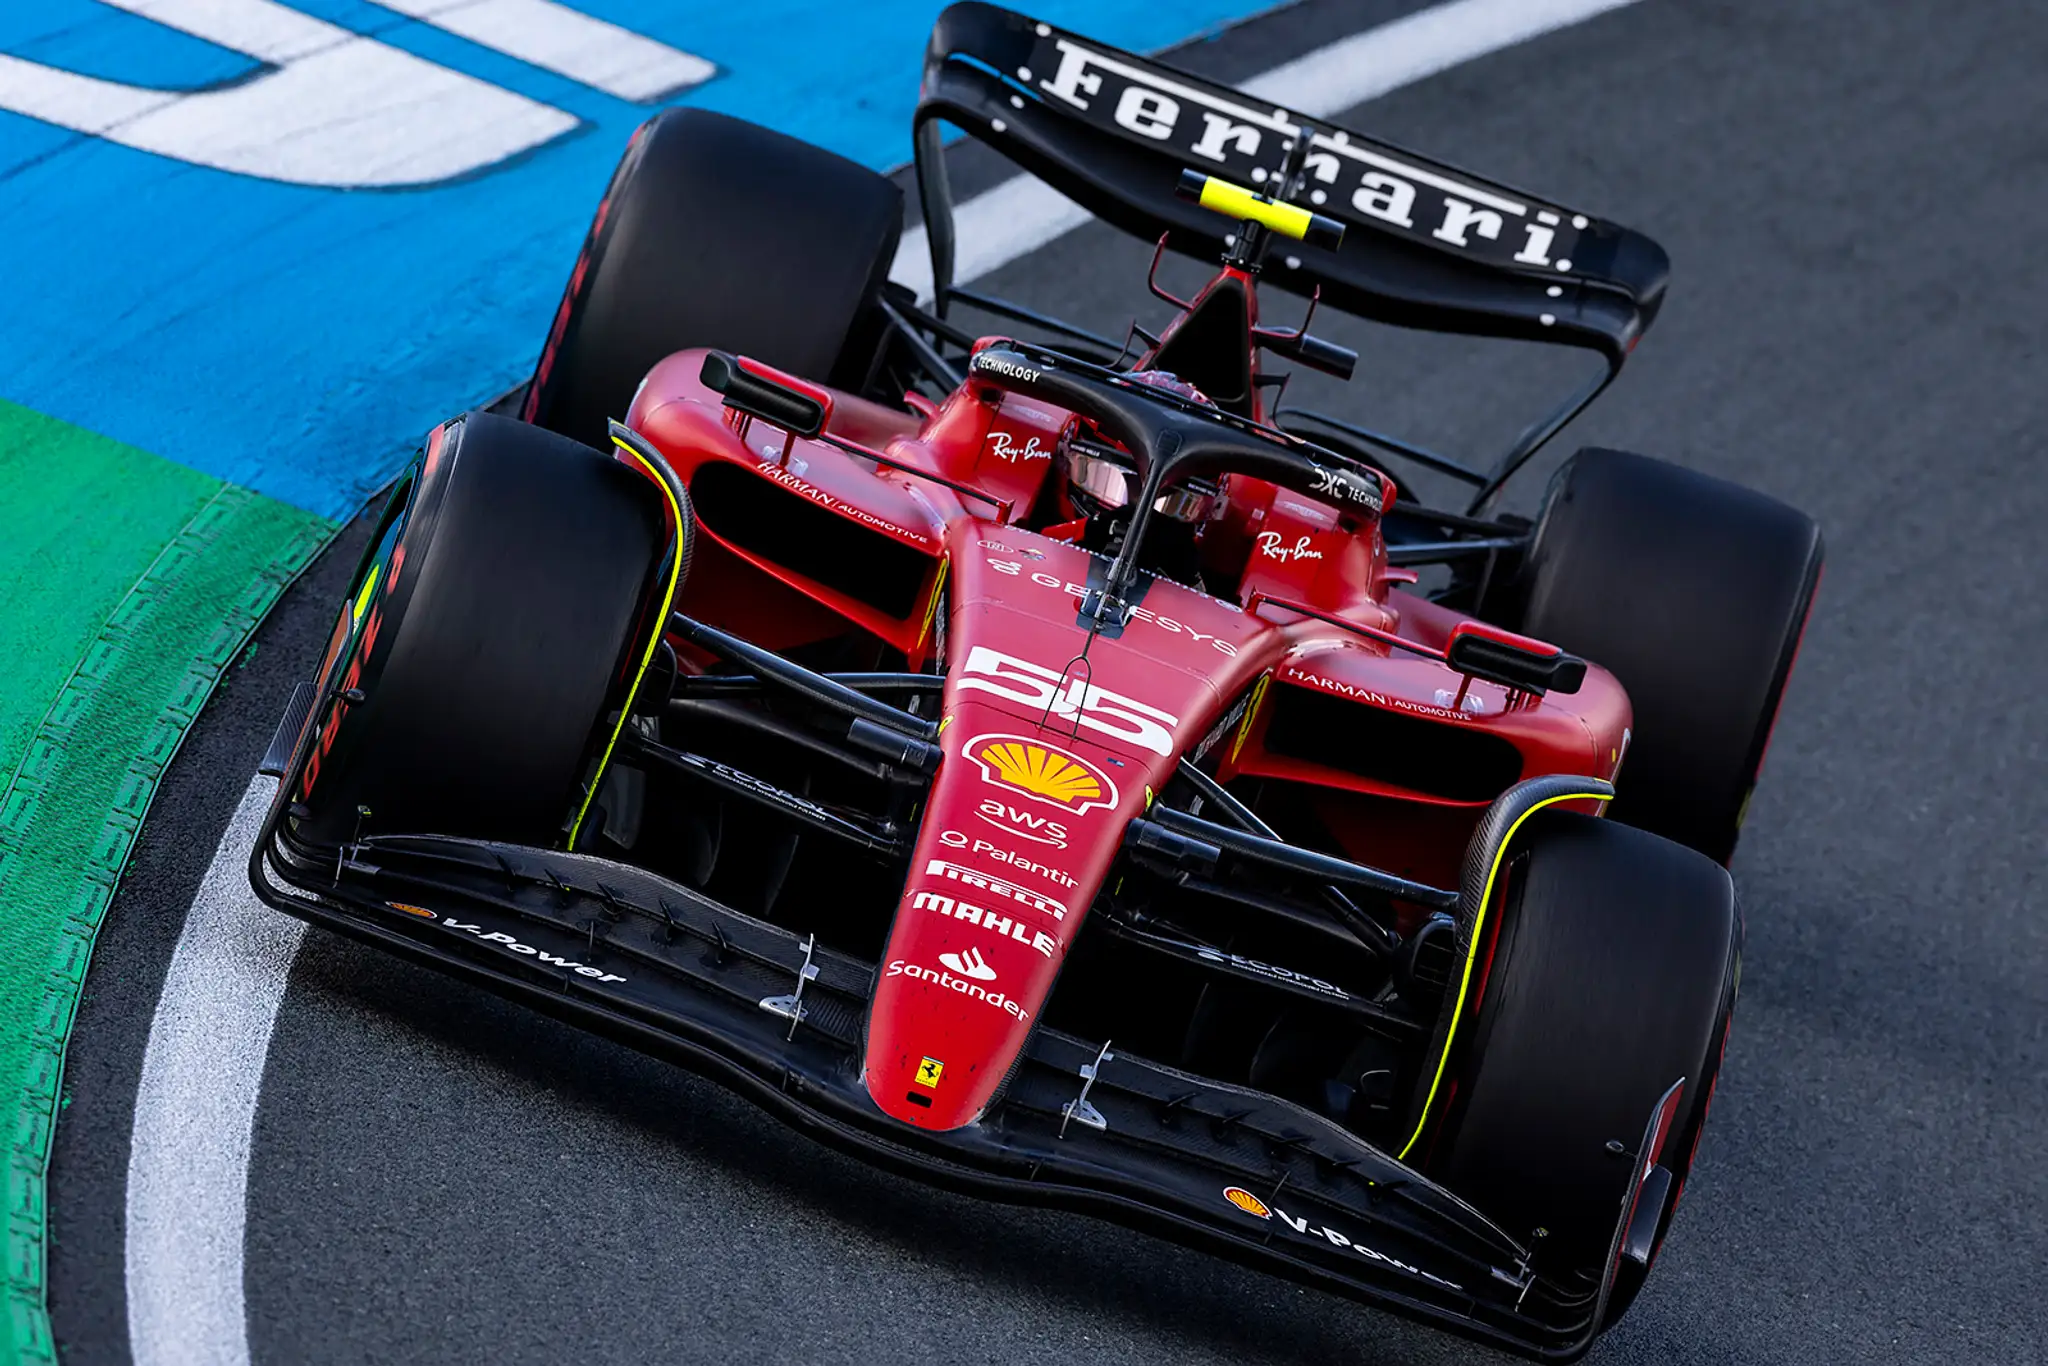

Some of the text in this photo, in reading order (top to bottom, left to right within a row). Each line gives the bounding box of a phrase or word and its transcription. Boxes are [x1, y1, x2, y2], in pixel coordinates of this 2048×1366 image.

[977, 355, 1041, 383] TECHNOLOGY
[757, 461, 928, 543] HARMAN AUTOMOTIVE
[1309, 468, 1347, 499] DXC
[1031, 573, 1238, 658] GEESYS
[956, 646, 1179, 757] 55
[1288, 667, 1471, 721] HARMAN AUTOMOTIVE
[978, 798, 1069, 840] aws
[925, 859, 1069, 922] PIRELLI
[972, 839, 1079, 889] Palantir
[443, 917, 627, 983] V-Power
[912, 892, 1055, 958] MAHLE
[886, 959, 1029, 1023] Santander
[1230, 953, 1349, 997] ECOPOL
